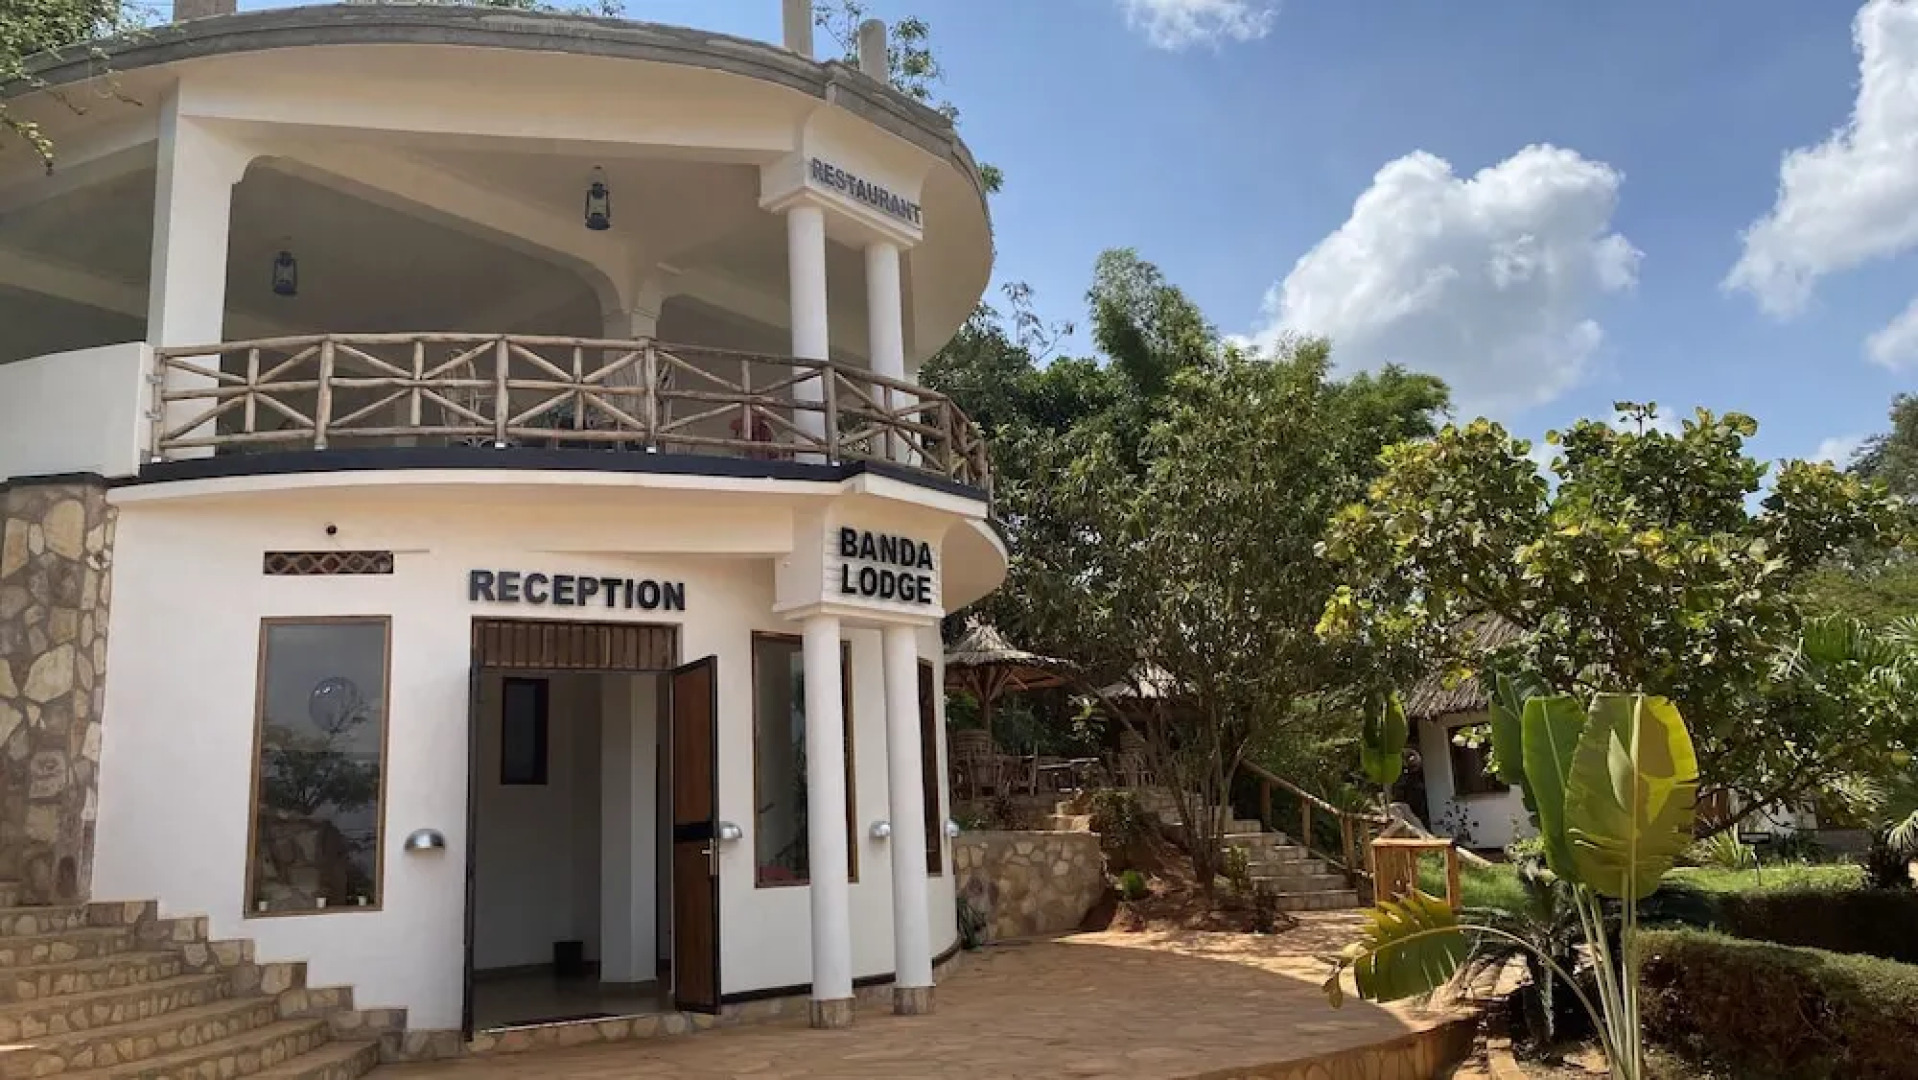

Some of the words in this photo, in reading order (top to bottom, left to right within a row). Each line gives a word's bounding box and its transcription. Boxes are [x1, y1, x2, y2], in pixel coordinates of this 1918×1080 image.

[811, 157, 922, 224] RESTAURANT
[841, 526, 933, 570] BANDA
[469, 569, 686, 611] RECEPTION
[841, 563, 932, 604] LODGE
